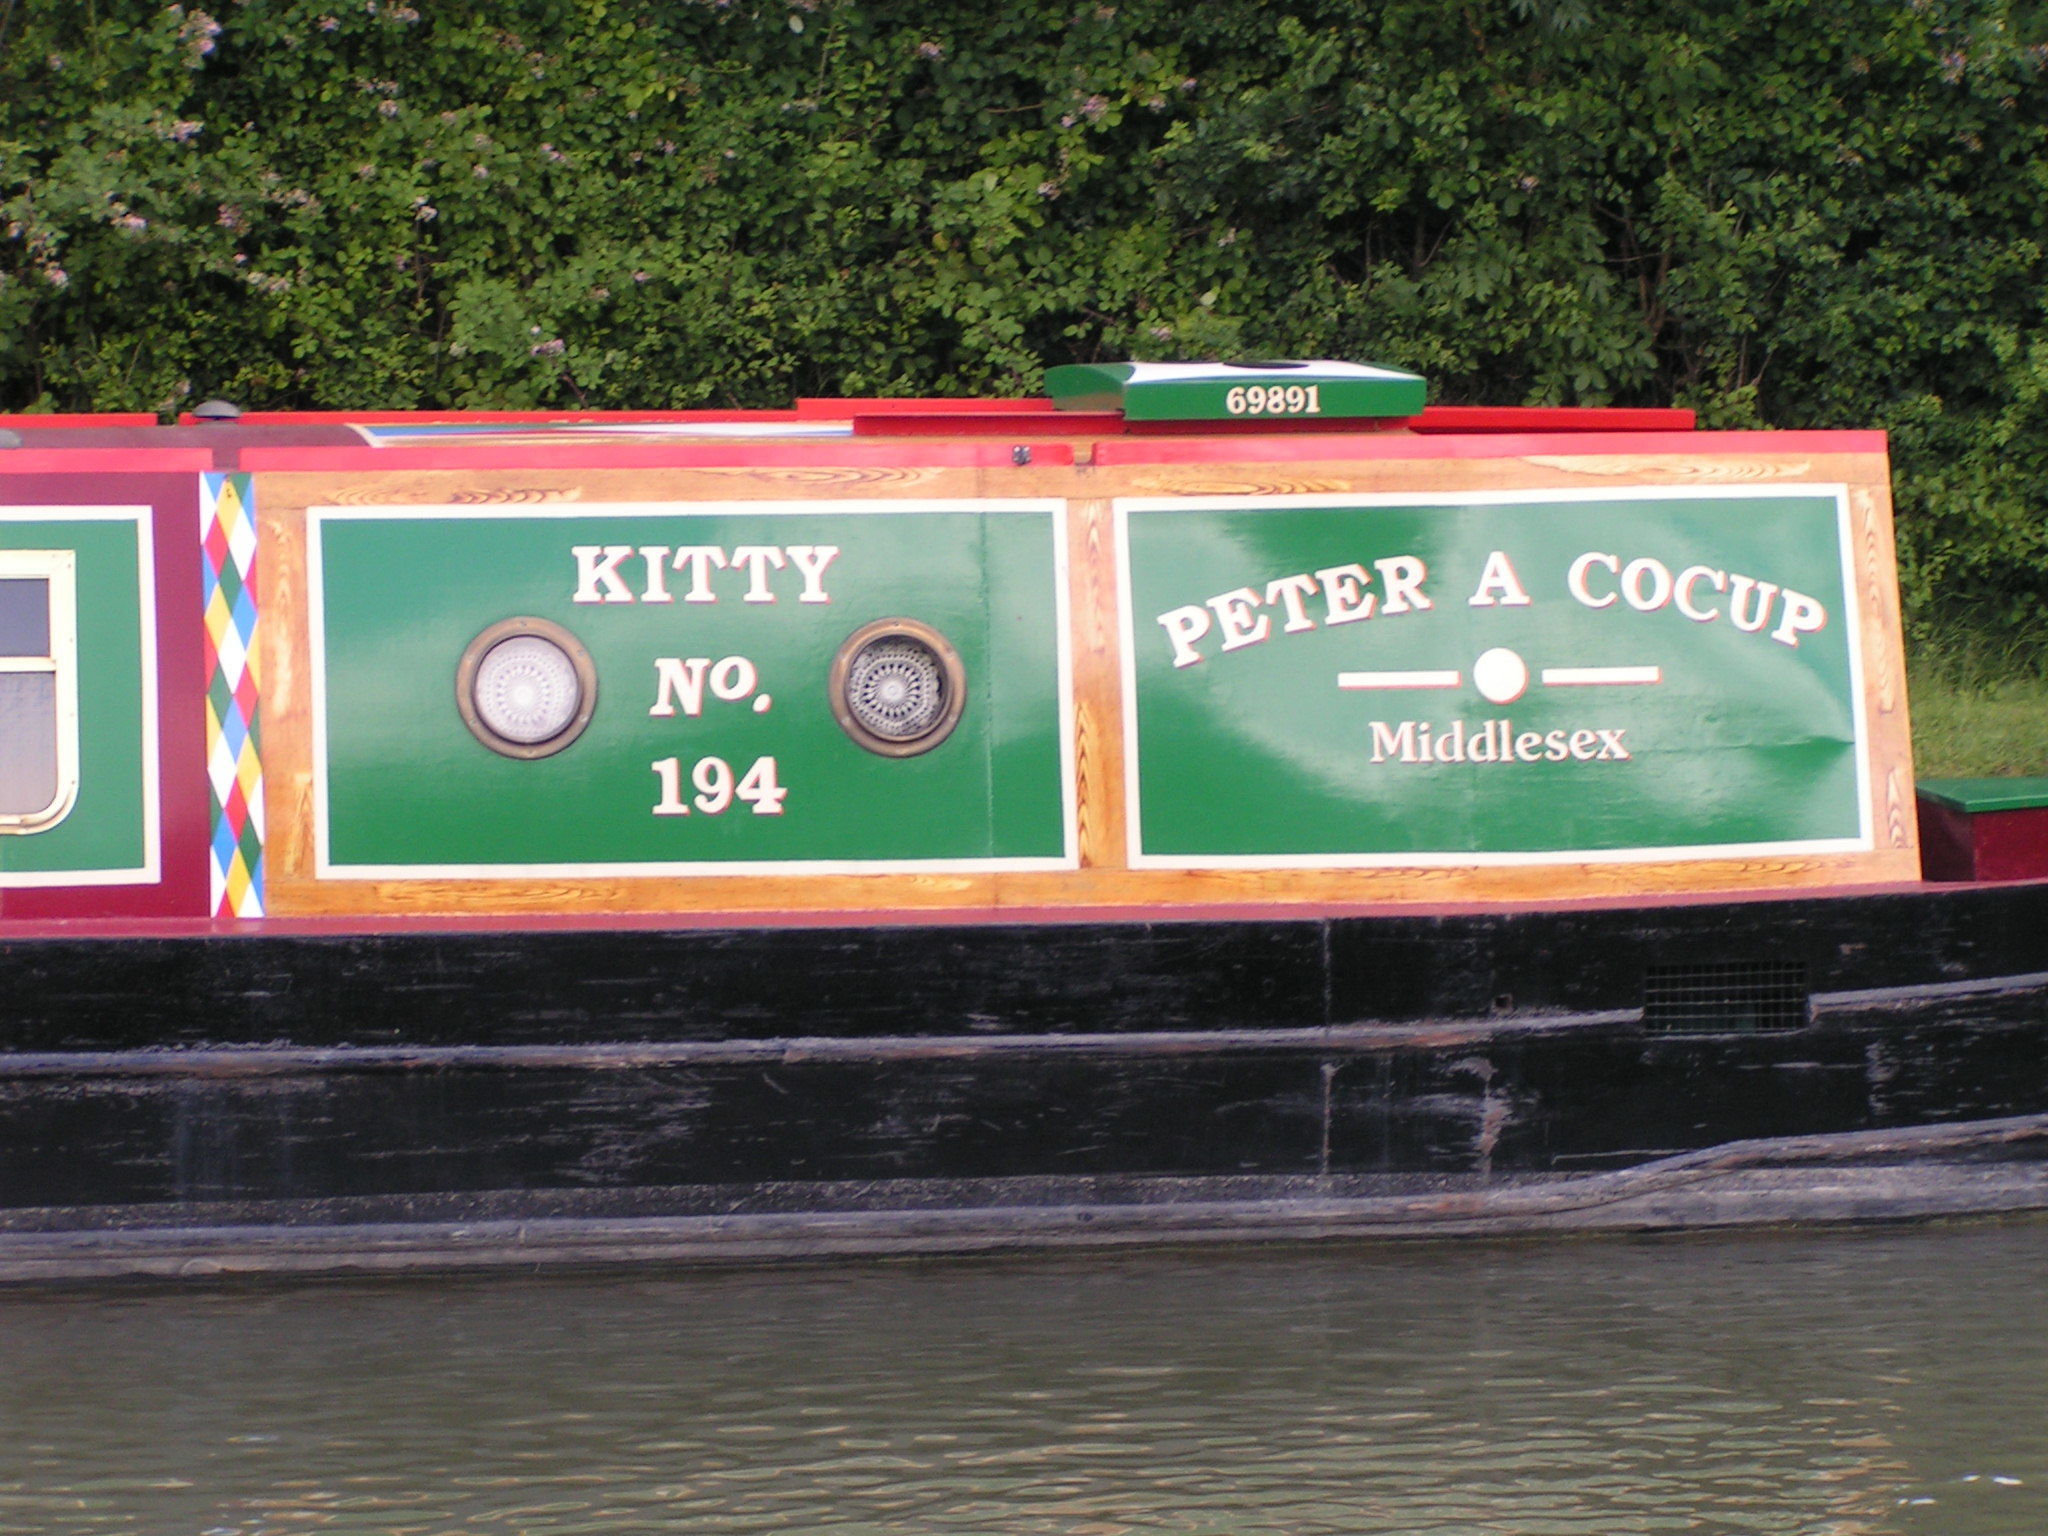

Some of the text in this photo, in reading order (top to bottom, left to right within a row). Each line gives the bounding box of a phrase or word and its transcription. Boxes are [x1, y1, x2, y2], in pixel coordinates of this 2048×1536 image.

[1226, 385, 1321, 415] 69891
[571, 546, 839, 604] KITTY
[1157, 551, 1828, 670] PETER A COCUP
[1368, 719, 1632, 765] Middlesex
[651, 756, 787, 816] 194
